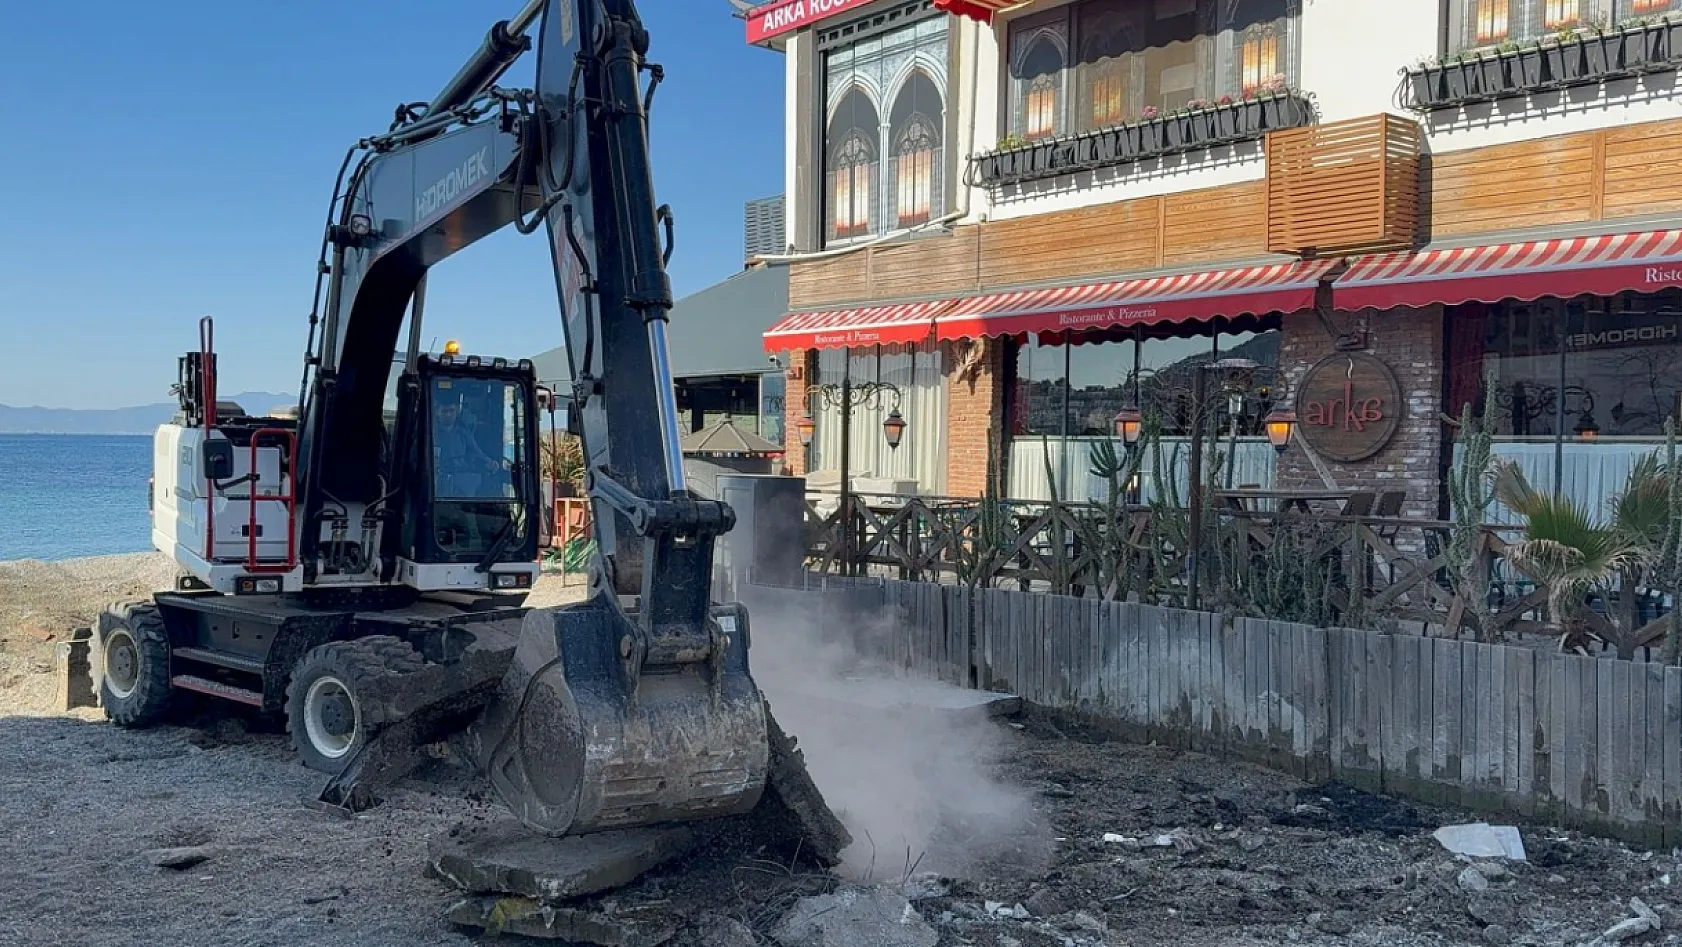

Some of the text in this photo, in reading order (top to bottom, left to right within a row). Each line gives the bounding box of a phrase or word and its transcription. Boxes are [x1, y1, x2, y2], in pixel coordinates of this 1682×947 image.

[762, 0, 805, 33] ARKA
[1059, 305, 1157, 325] Ristorante & Pizzeria
[814, 330, 880, 344] Ristorante & Pizzeria
